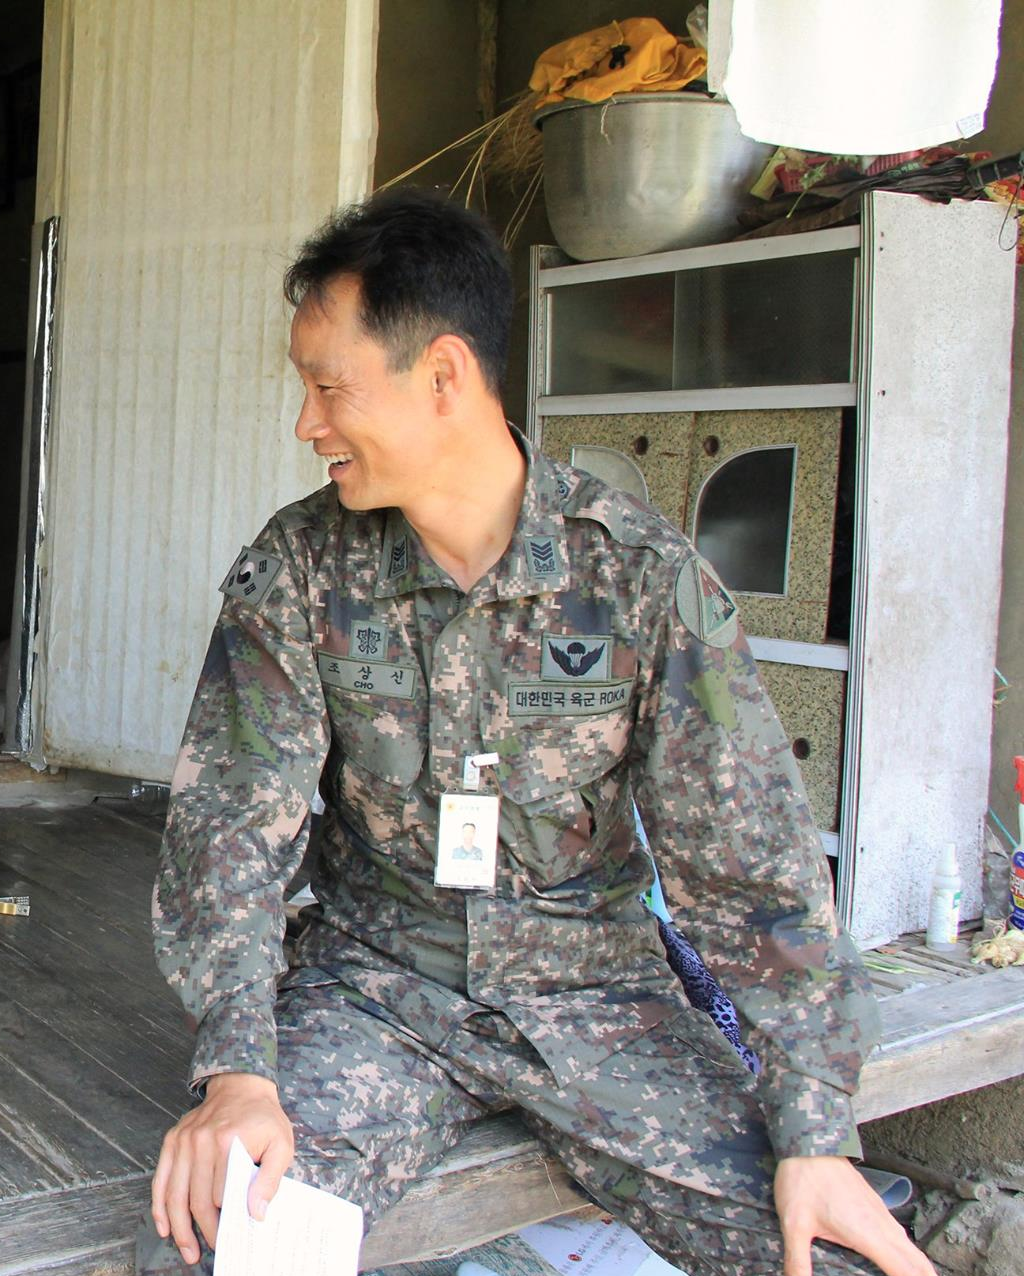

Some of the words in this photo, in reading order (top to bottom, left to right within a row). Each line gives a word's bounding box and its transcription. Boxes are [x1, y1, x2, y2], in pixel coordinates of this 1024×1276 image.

[354, 681, 374, 690] CHO
[516, 691, 565, 707] 대한민국
[570, 692, 595, 707] 육군
[599, 688, 625, 705] ROKA
